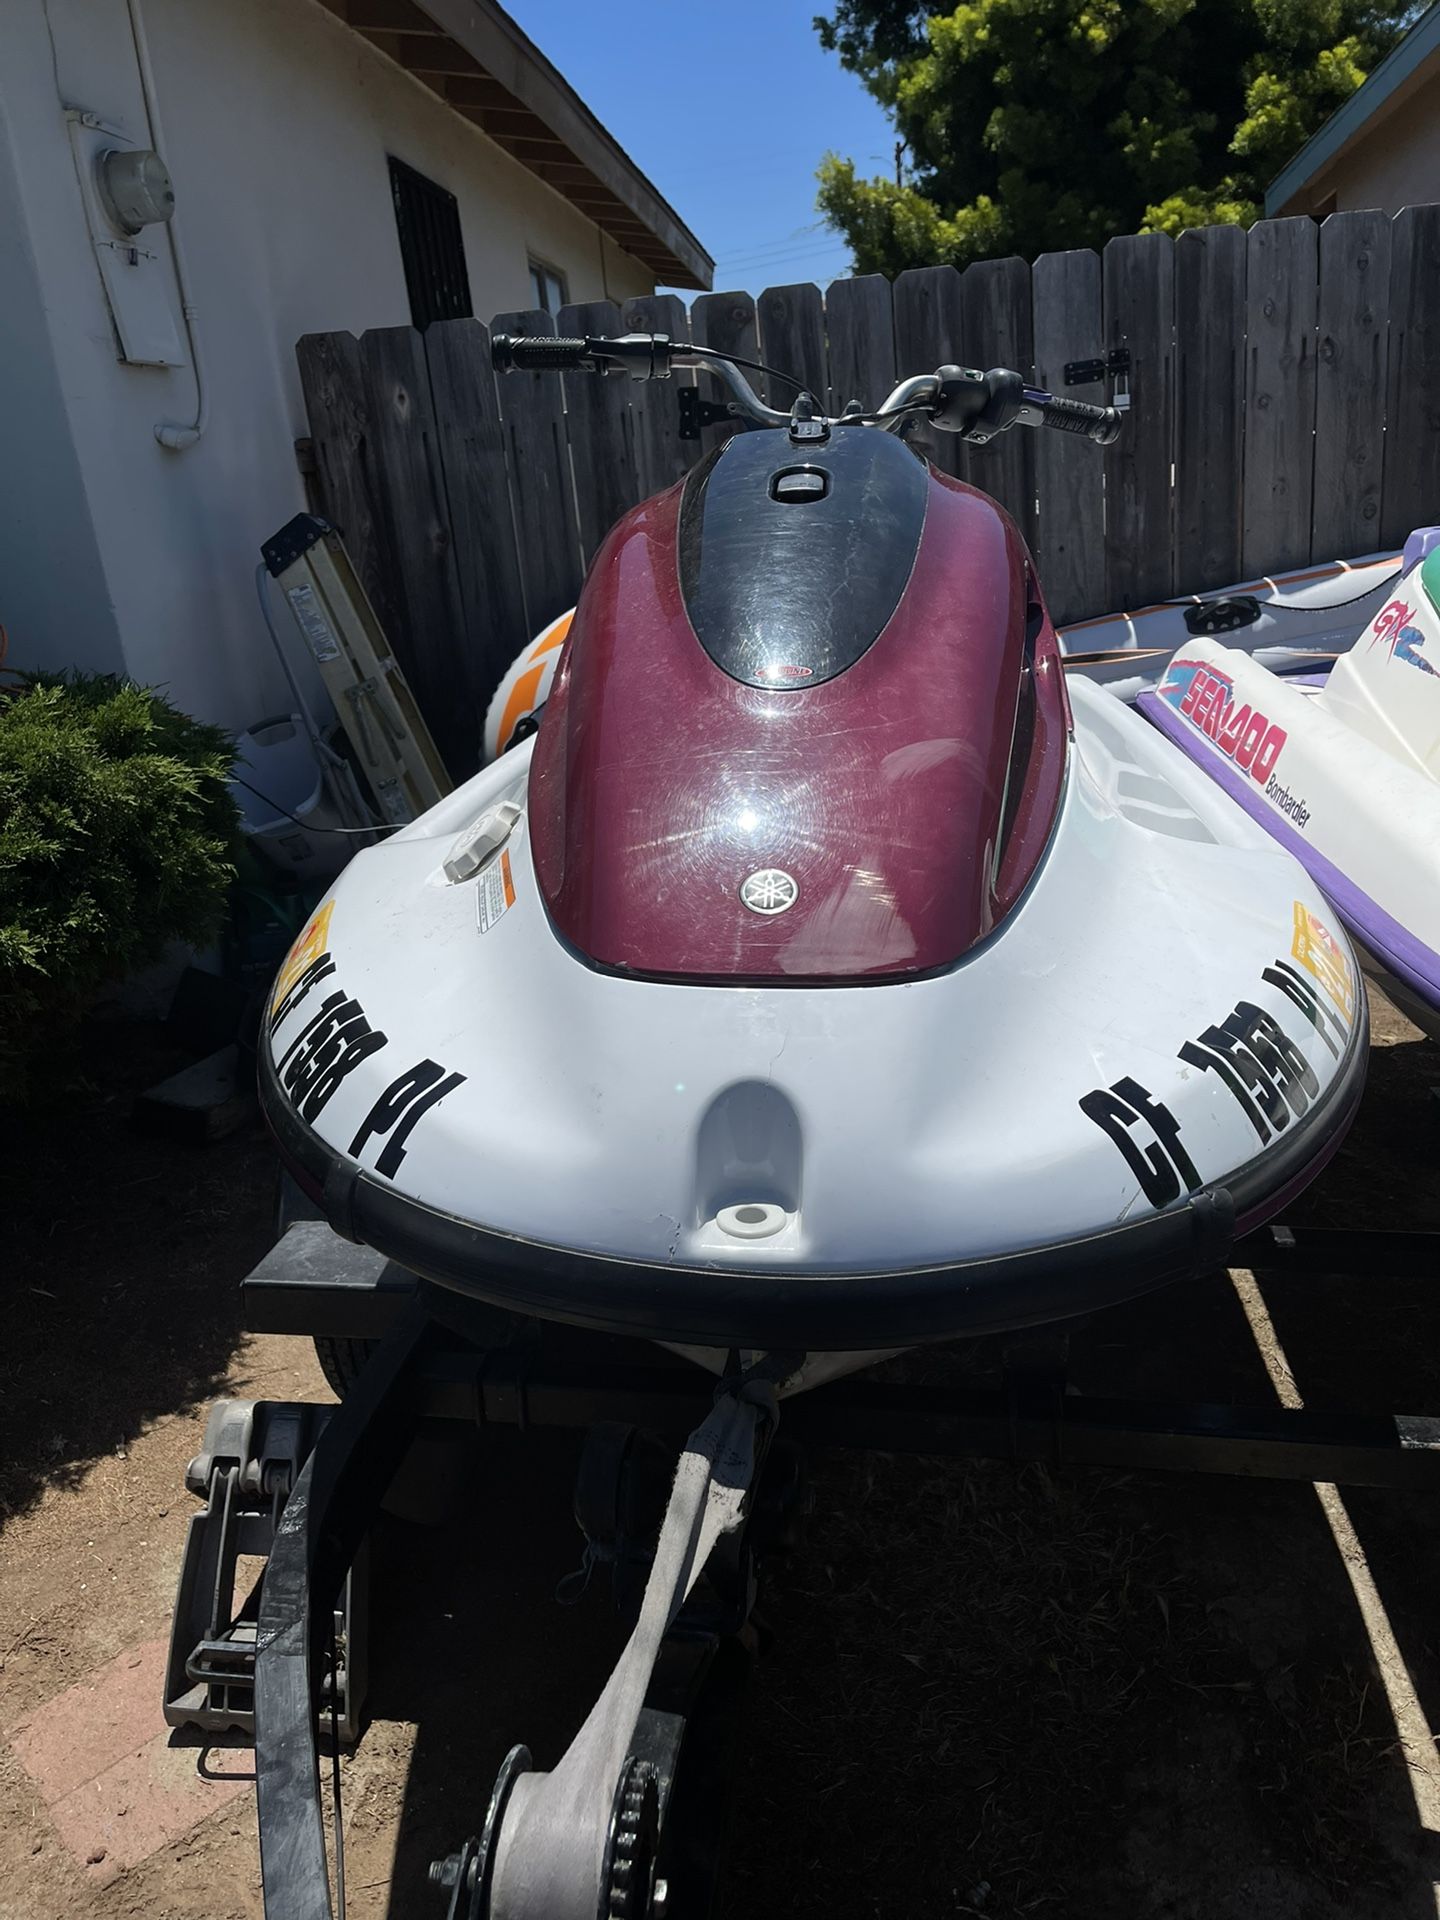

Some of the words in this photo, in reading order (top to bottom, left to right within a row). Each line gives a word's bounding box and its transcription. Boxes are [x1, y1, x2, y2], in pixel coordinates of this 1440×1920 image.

[1265, 773, 1311, 829] Bombardier
[276, 989, 389, 1126] 1558
[347, 1058, 468, 1180] PL
[1079, 1076, 1204, 1210] CF
[1177, 1001, 1320, 1147] 1558
[1261, 959, 1348, 1061] PL
